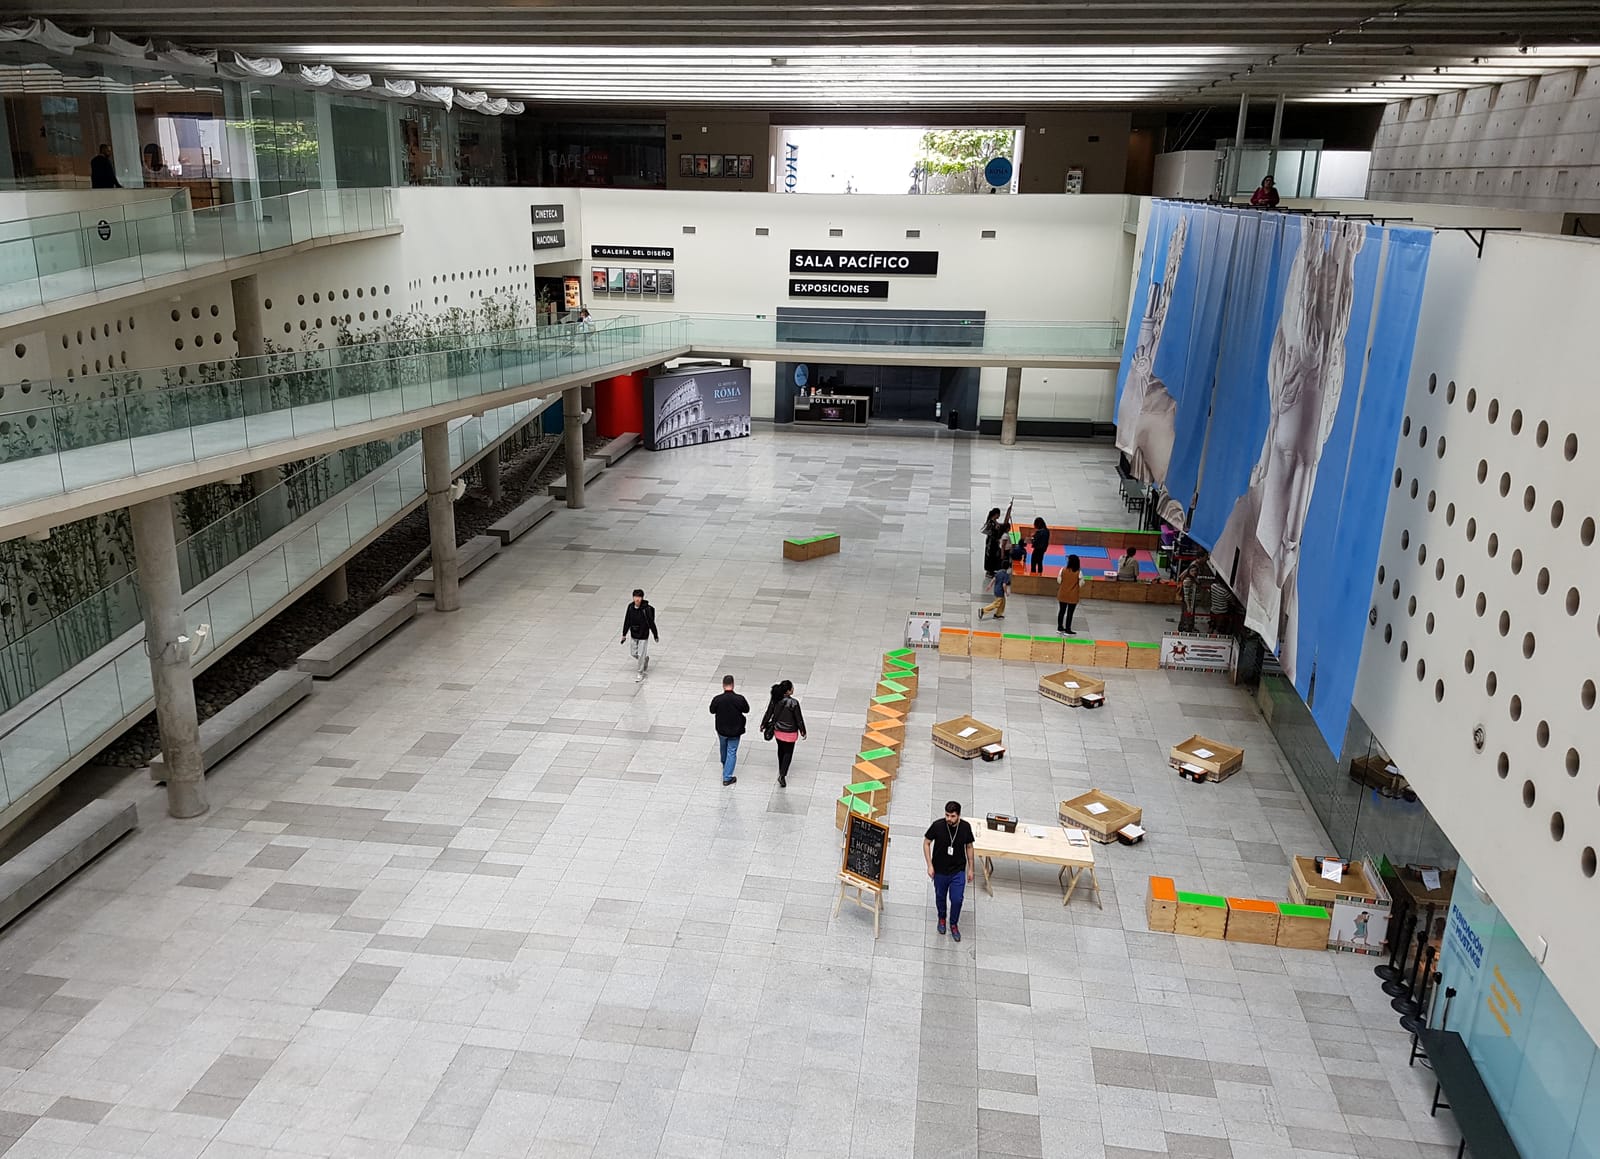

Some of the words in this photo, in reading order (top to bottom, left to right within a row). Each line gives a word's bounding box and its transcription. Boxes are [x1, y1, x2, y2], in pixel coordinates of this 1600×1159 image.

[535, 209, 558, 219] CINETECA
[536, 233, 559, 245] NACIONAL
[601, 248, 630, 256] GALERÍA
[632, 249, 645, 257] DEL
[646, 249, 671, 258] DISEÑO
[795, 255, 834, 269] SALA
[838, 253, 910, 270] PACÍFICO
[794, 283, 870, 294] EXPOSICIONES
[714, 387, 742, 399] ROMA
[1452, 904, 1484, 956] FUNDACIÓN
[1455, 926, 1481, 969] MUSTAKIS
